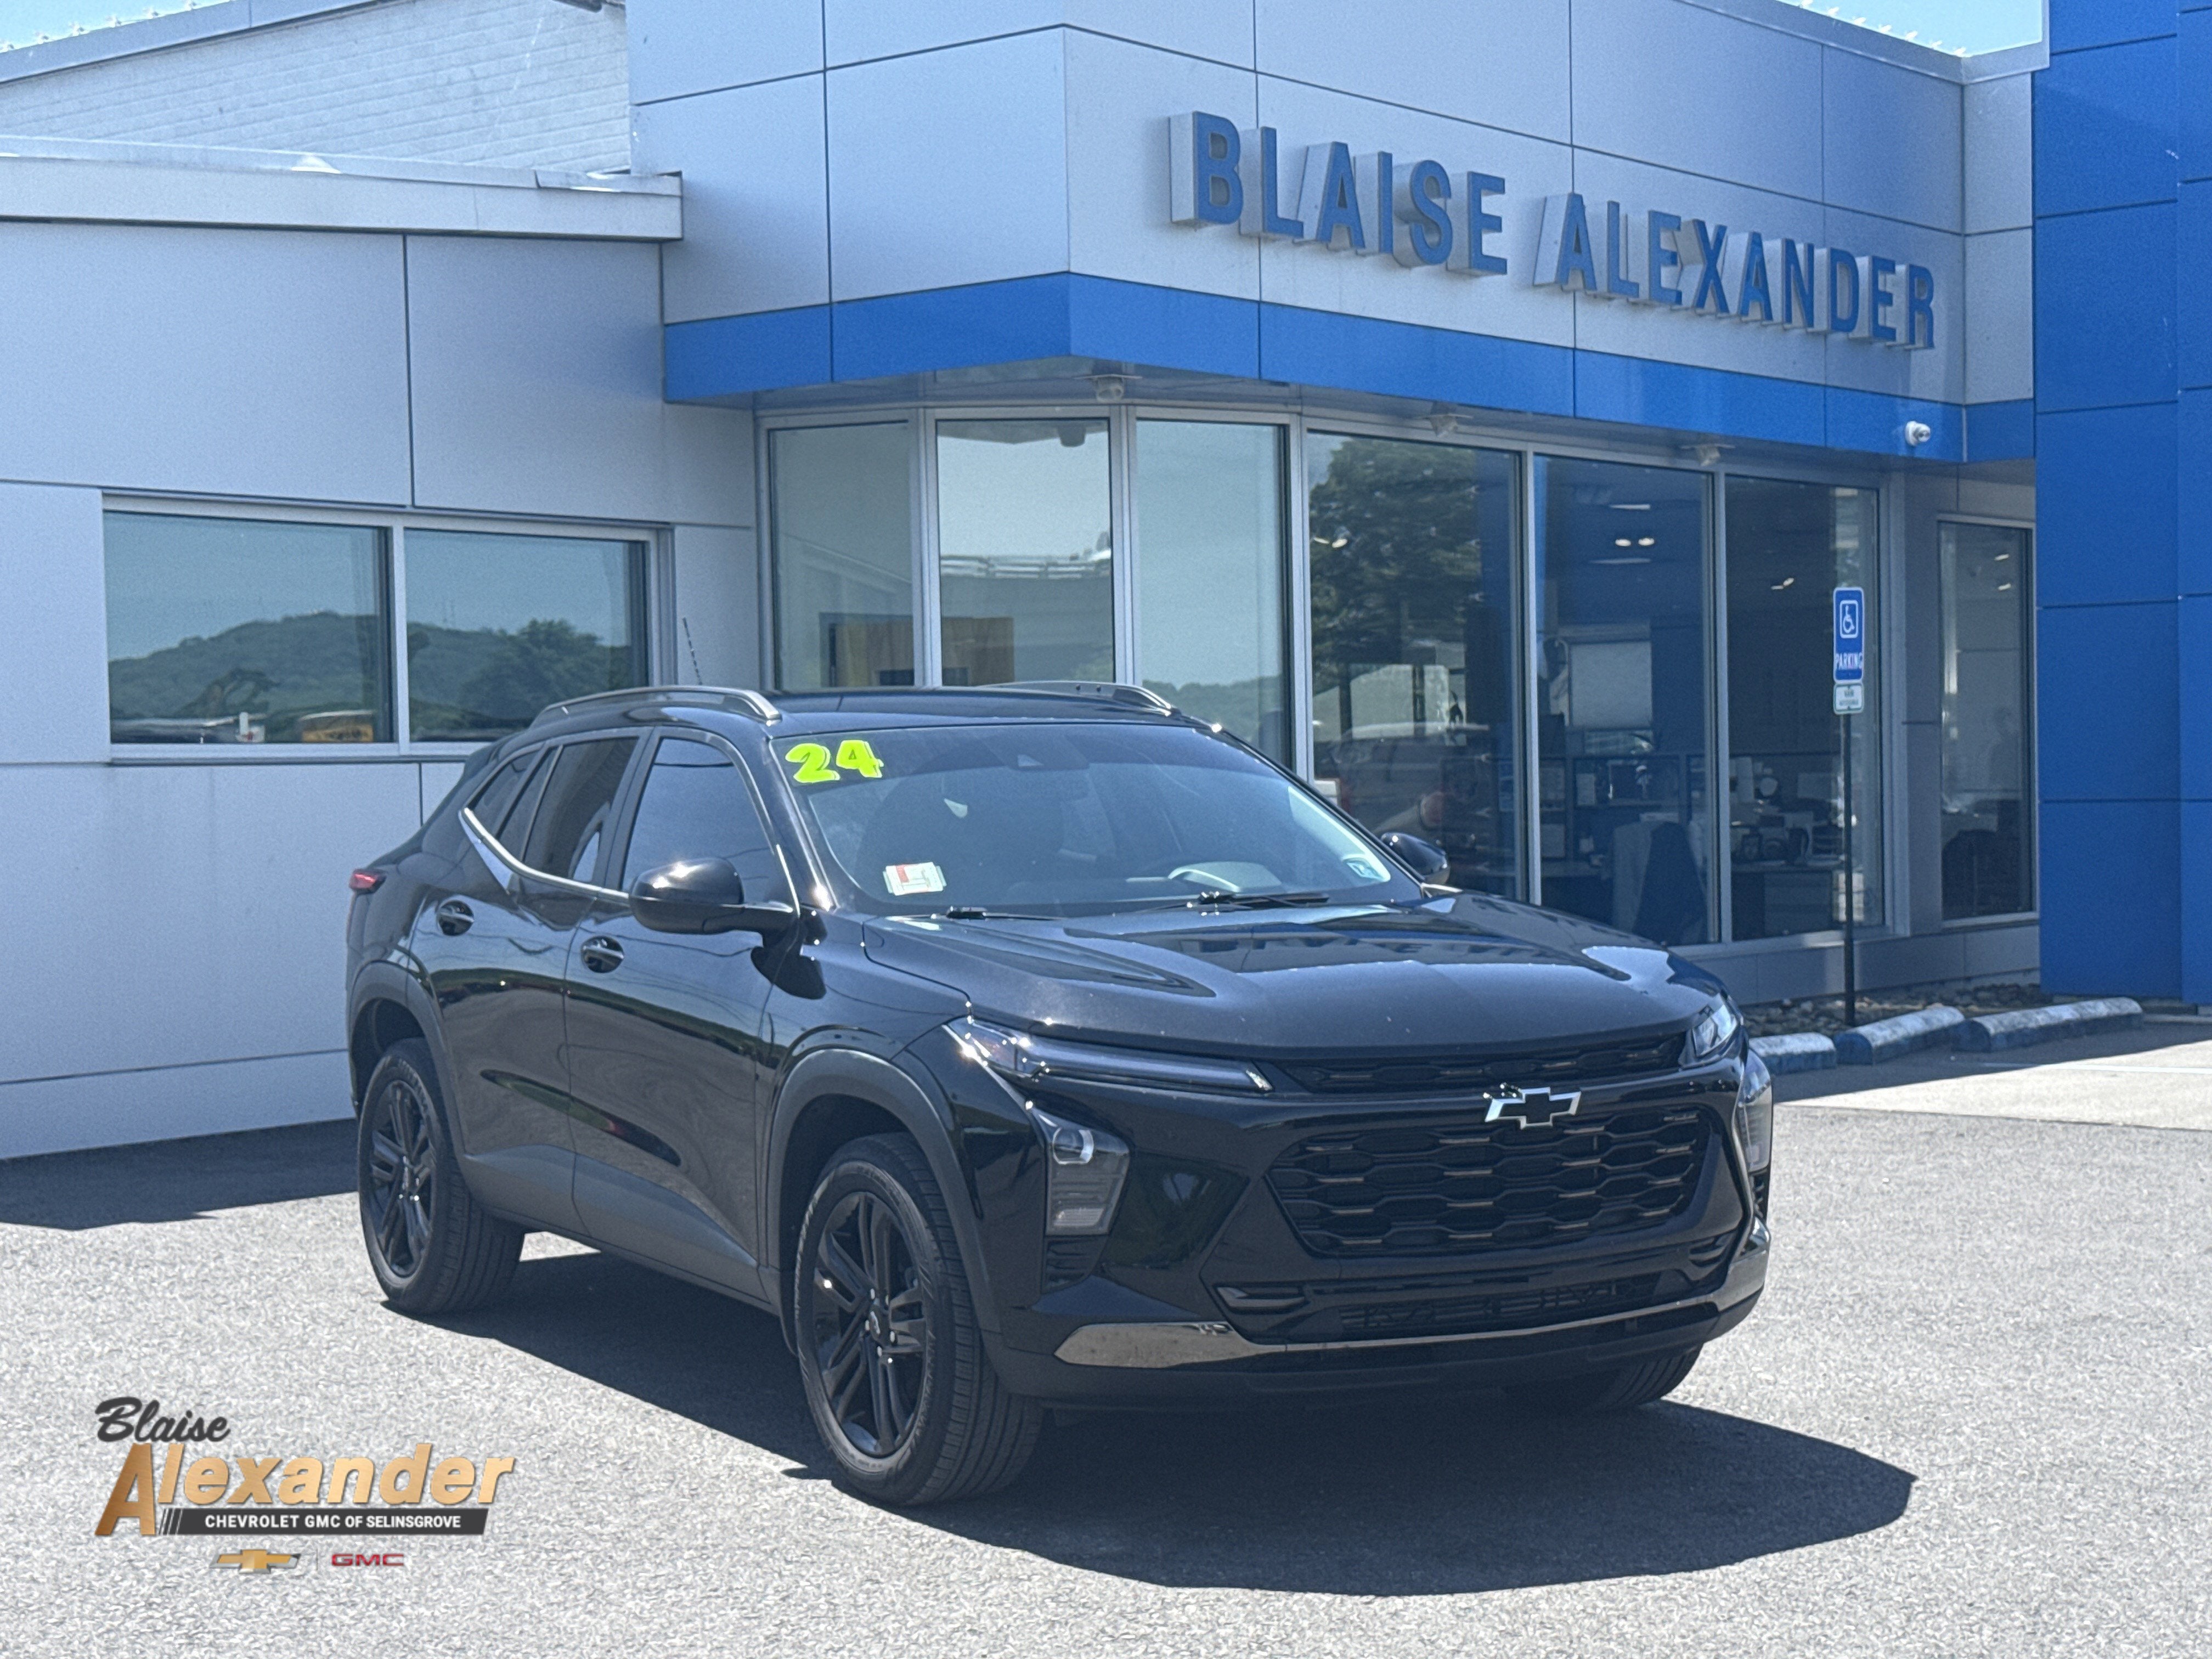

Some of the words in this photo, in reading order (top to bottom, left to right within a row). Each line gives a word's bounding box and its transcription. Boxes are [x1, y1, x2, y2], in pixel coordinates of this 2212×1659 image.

[1190, 110, 1508, 276] BLAISE
[1557, 191, 1936, 349] ALEXANDER
[1835, 652, 1863, 670] PARKING
[785, 740, 884, 783] 24
